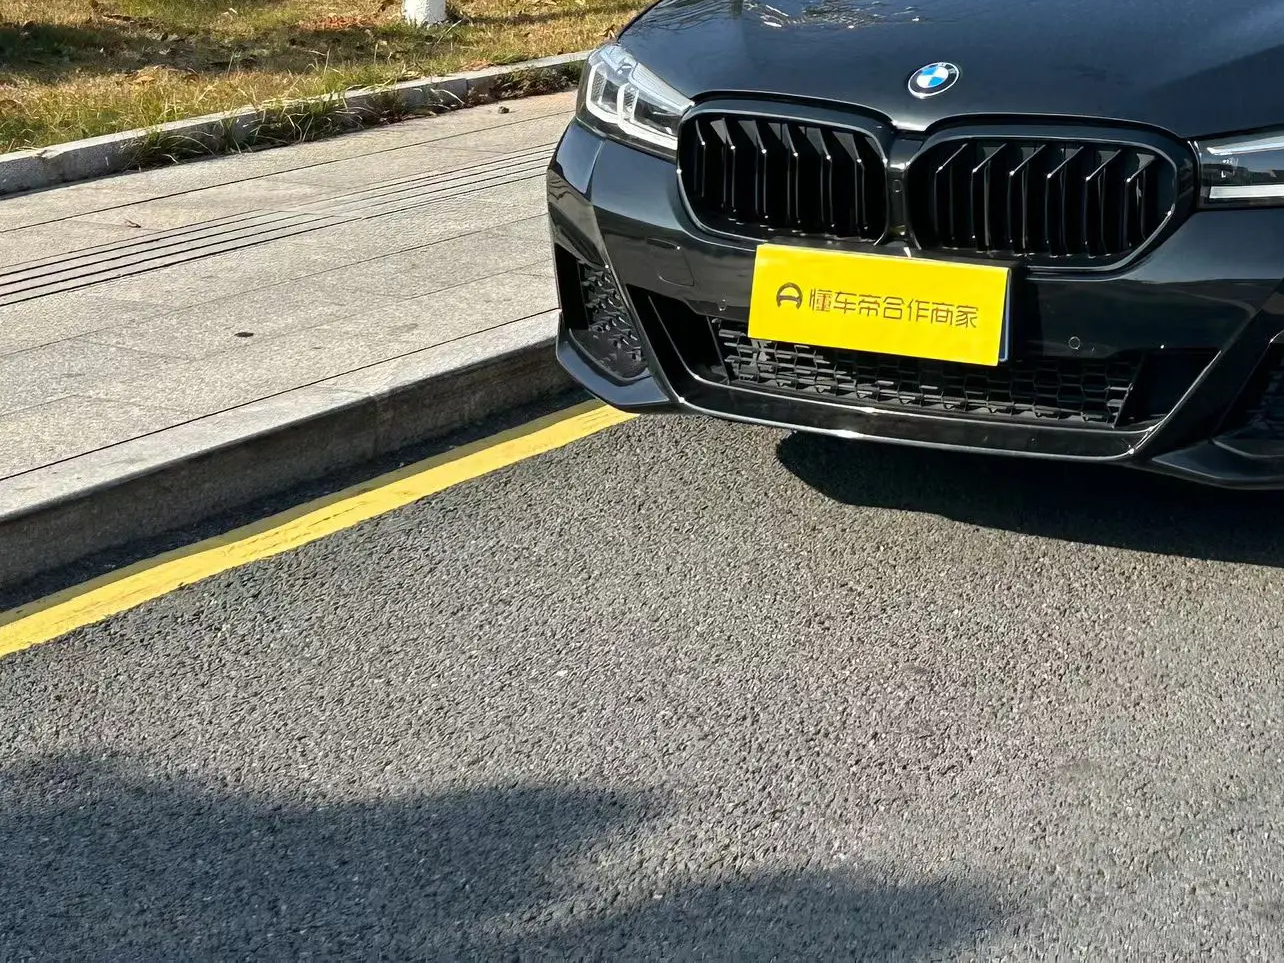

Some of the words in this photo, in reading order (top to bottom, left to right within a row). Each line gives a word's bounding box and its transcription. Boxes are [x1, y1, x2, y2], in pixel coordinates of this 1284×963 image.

[809, 288, 979, 328] 懂车帝合作商家
